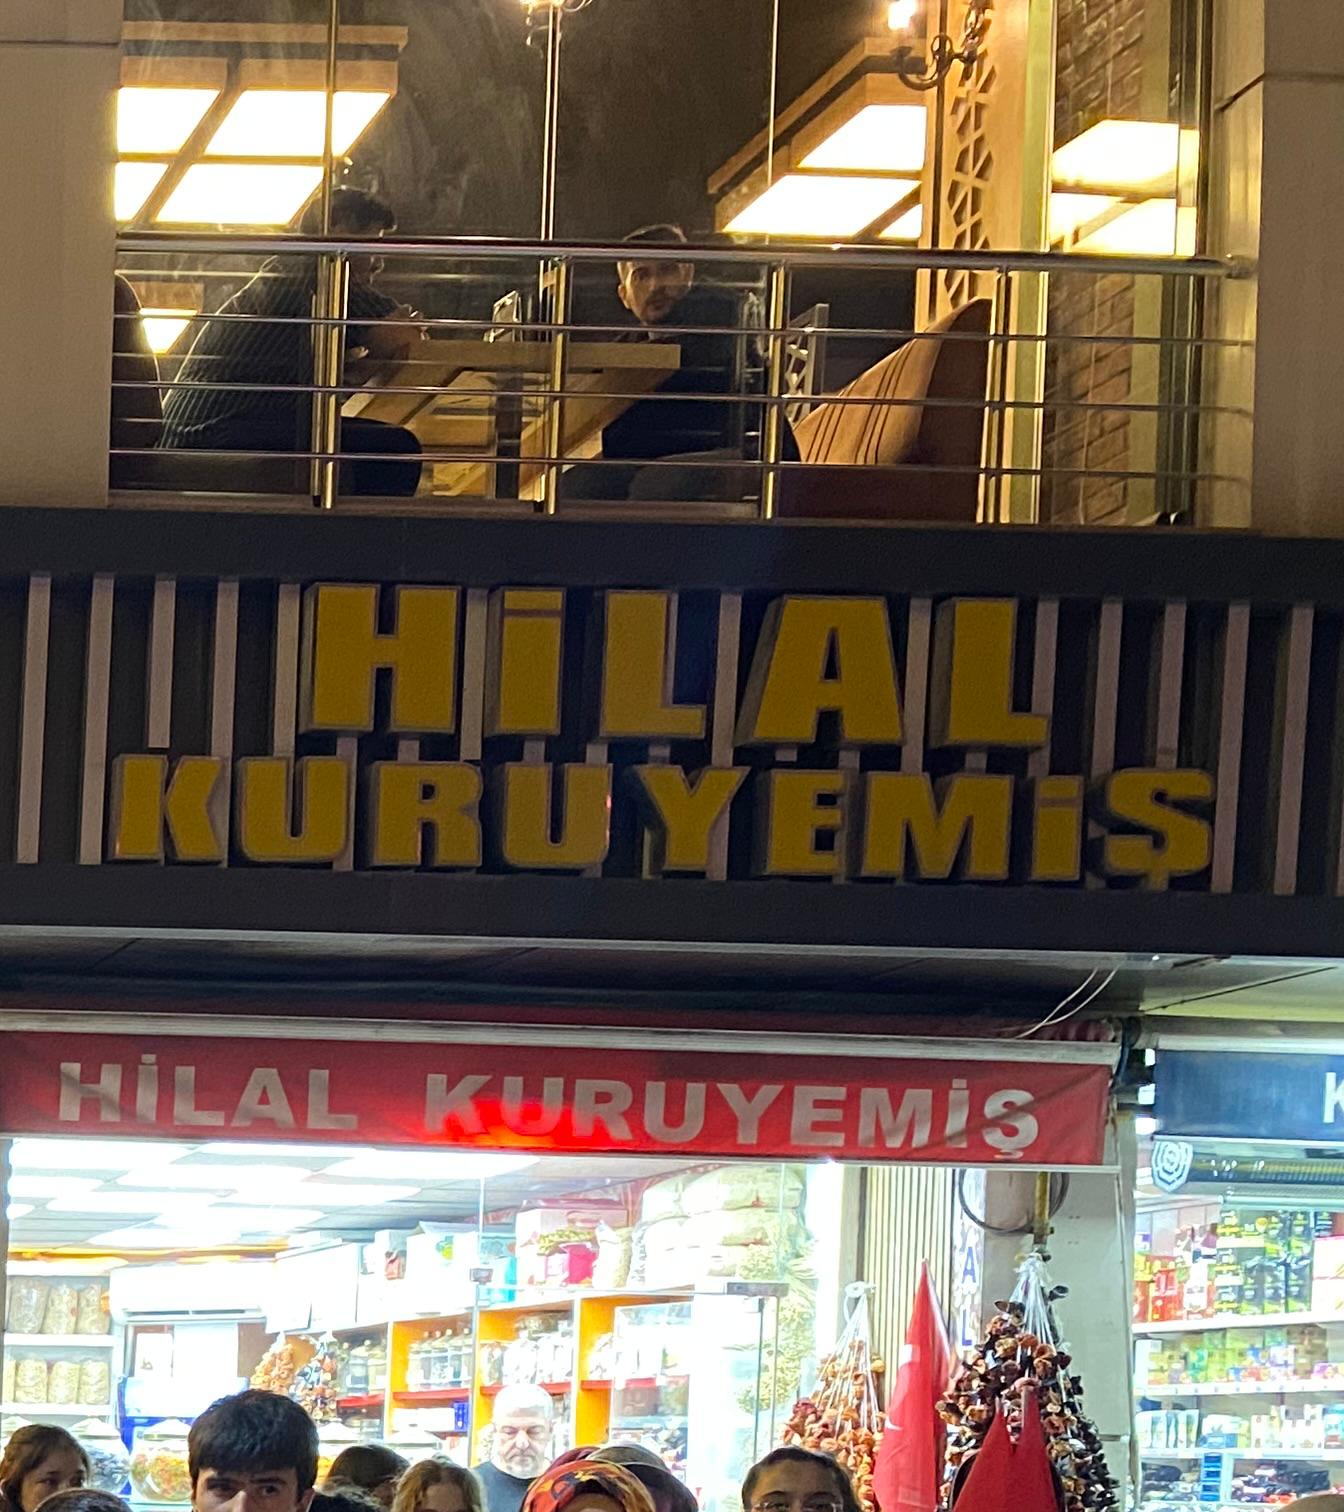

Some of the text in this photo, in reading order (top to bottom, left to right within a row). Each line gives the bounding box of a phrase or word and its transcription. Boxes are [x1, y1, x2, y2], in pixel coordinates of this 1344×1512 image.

[300, 580, 1054, 752] HİLAL
[114, 753, 1216, 888] KURUYEMİŞ
[59, 1053, 1041, 1158] HİLAL KURUYEMİŞ
